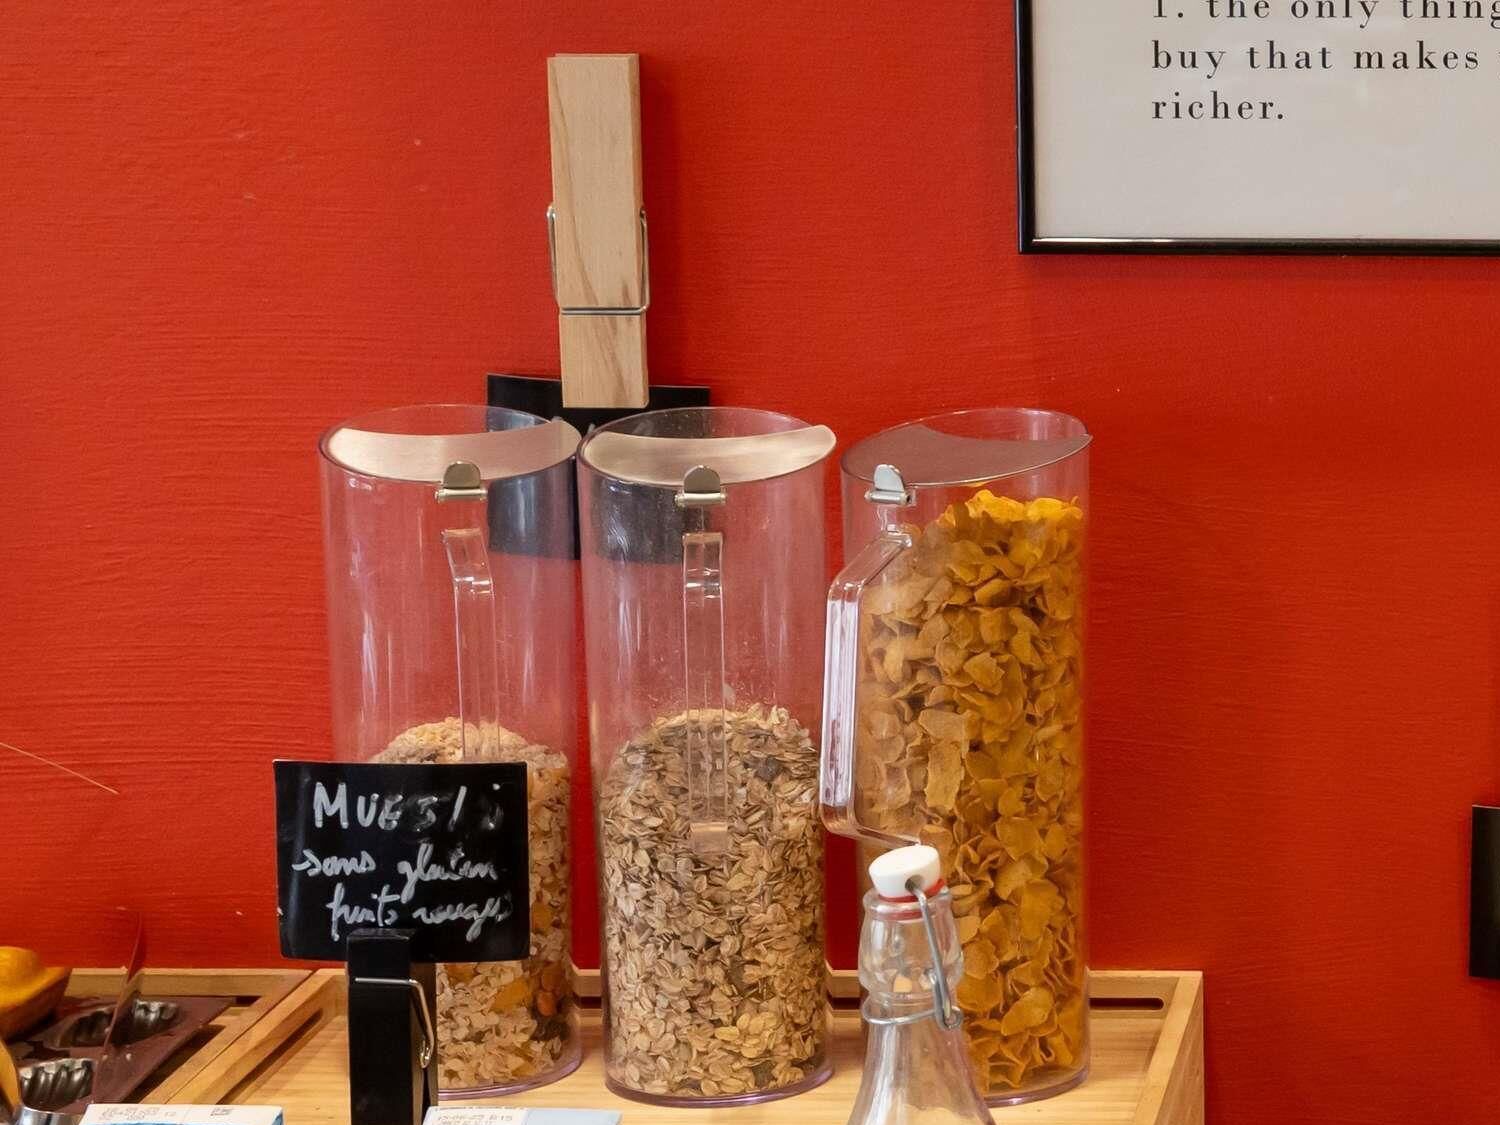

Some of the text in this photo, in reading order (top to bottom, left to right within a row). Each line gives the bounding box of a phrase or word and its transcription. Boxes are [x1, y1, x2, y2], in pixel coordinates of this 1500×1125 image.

[1206, 0, 1270, 19] the
[1291, 0, 1379, 28] only
[1151, 39, 1226, 79] buy
[1246, 39, 1332, 70] that
[1353, 39, 1479, 70] makes
[1151, 90, 1284, 120] richer.
